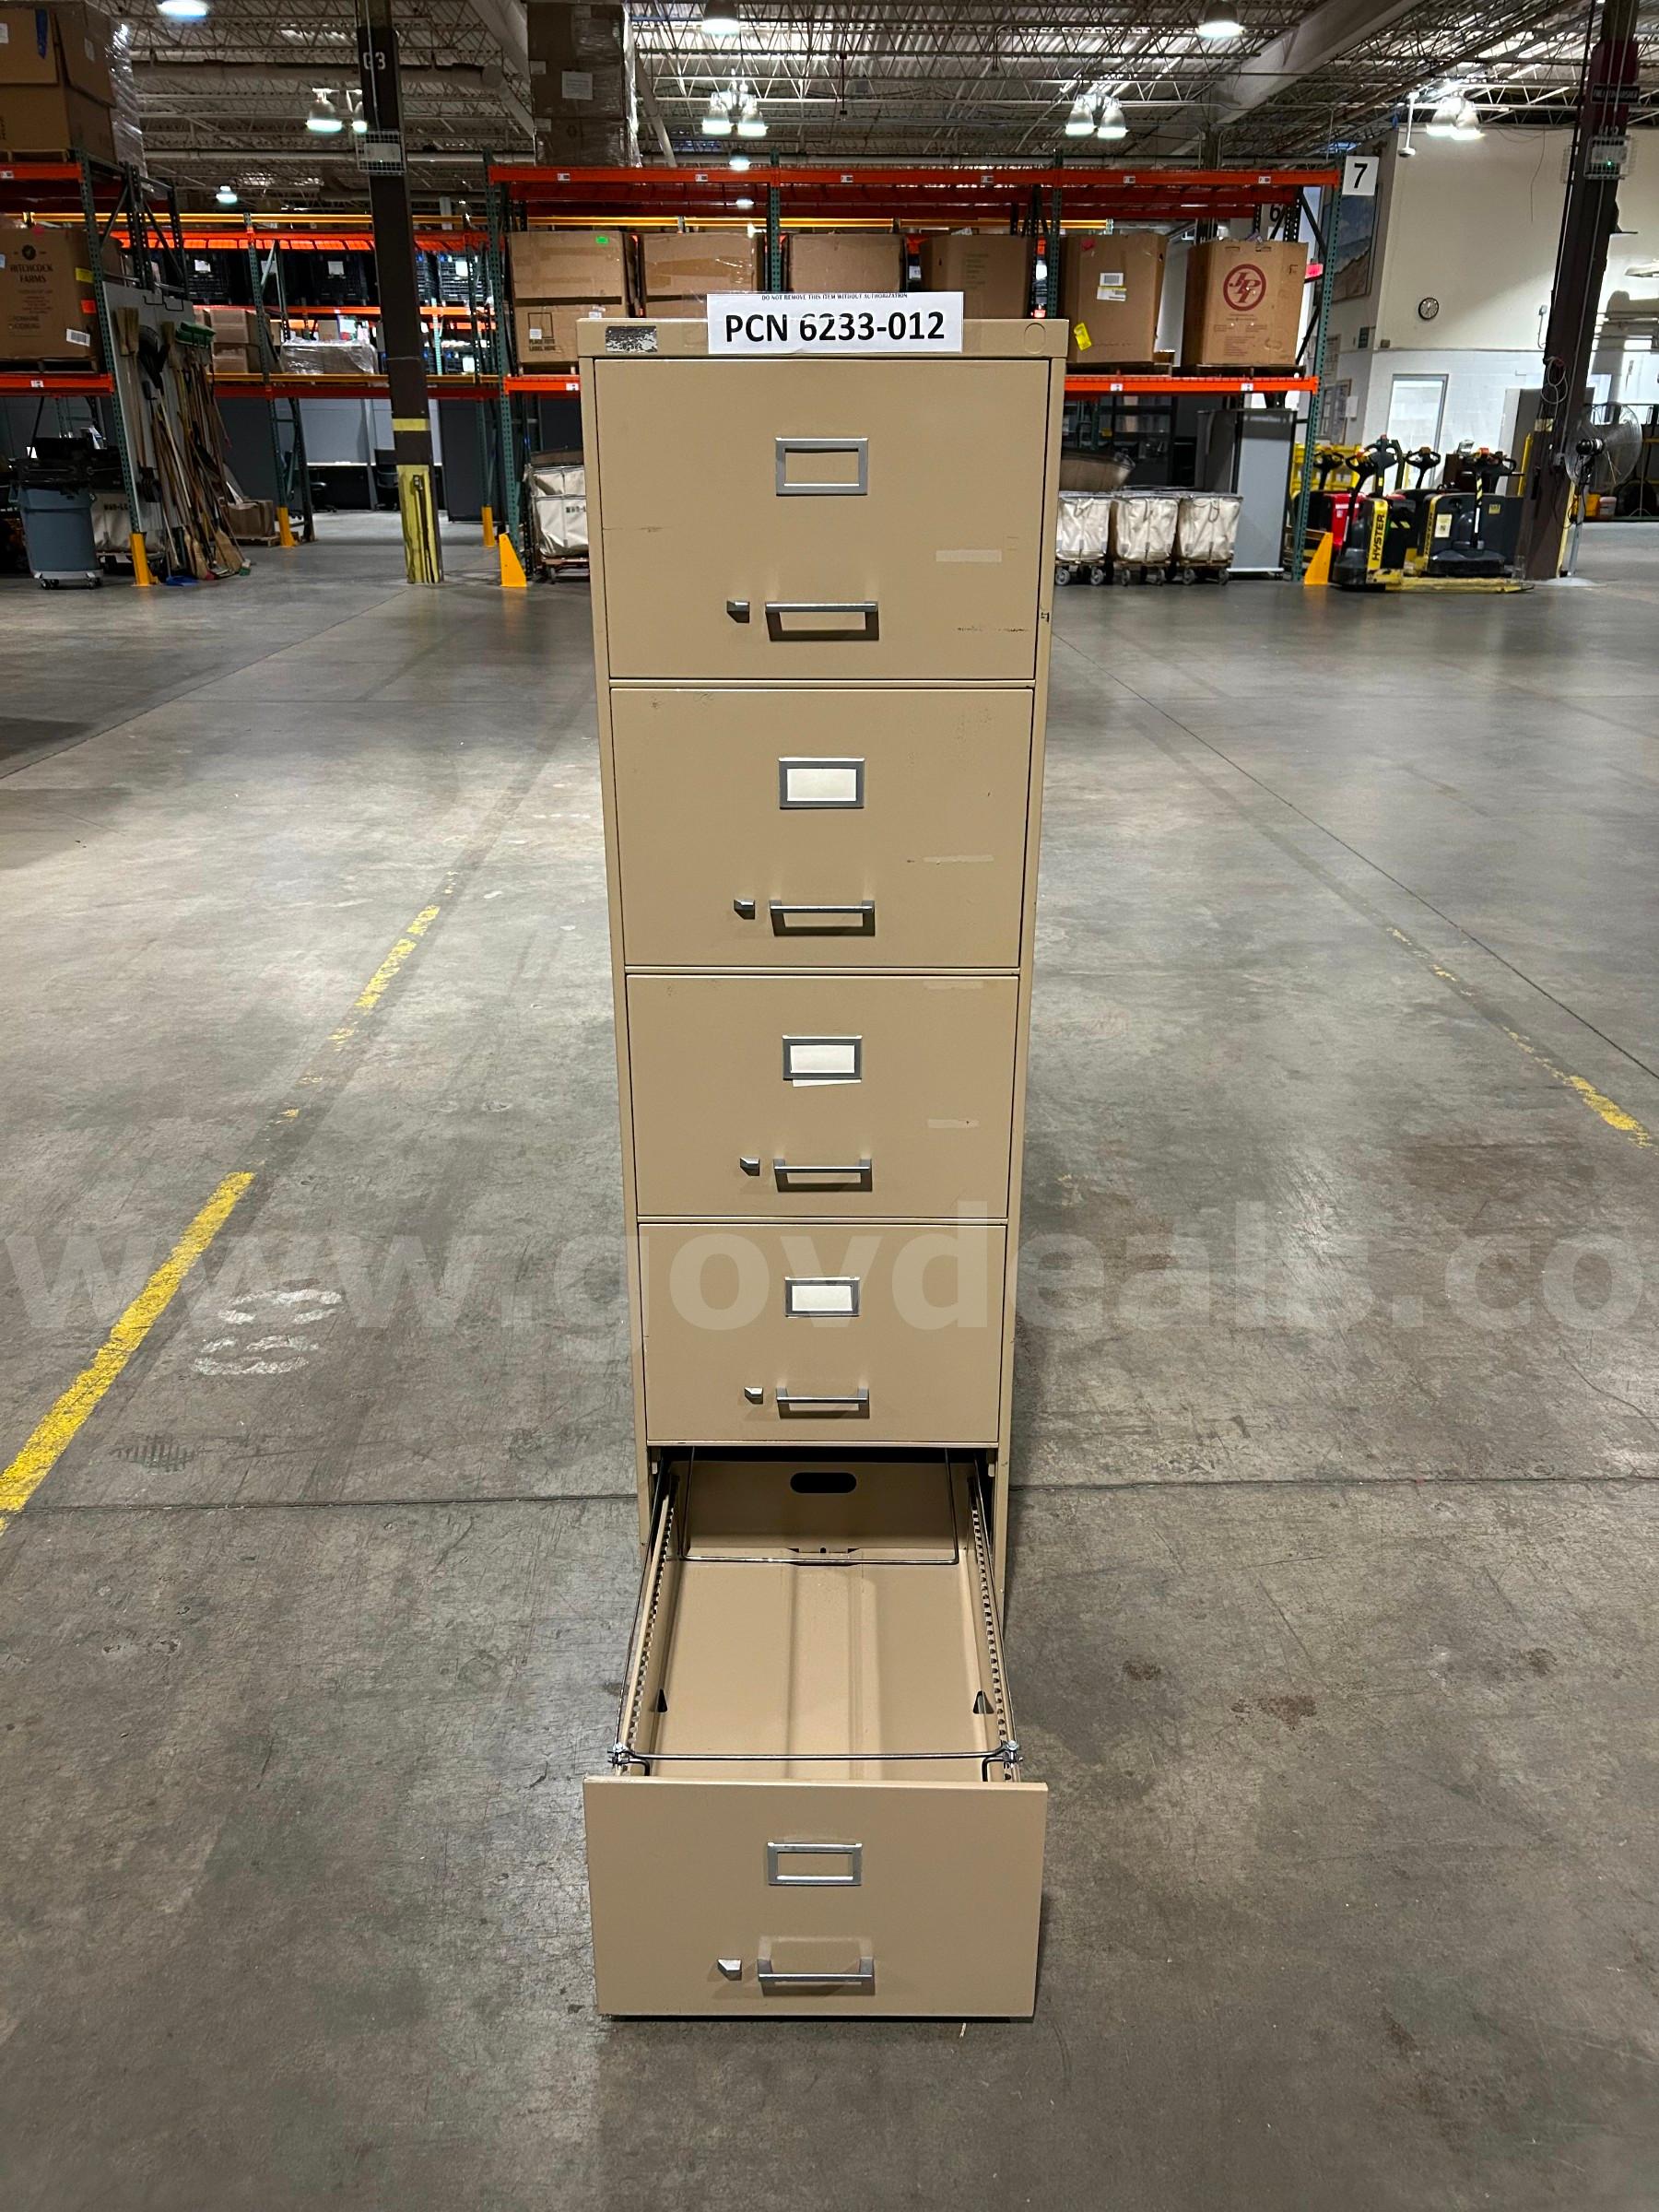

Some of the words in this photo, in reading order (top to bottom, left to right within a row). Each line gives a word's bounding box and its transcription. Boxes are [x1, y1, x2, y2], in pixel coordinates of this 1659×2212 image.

[1354, 163, 1368, 188] 7
[1269, 203, 1281, 222] 6
[20, 275, 47, 283] FARMS
[724, 313, 788, 342] PCN
[799, 311, 945, 342] 6233-012
[1372, 514, 1385, 561] HYSTER
